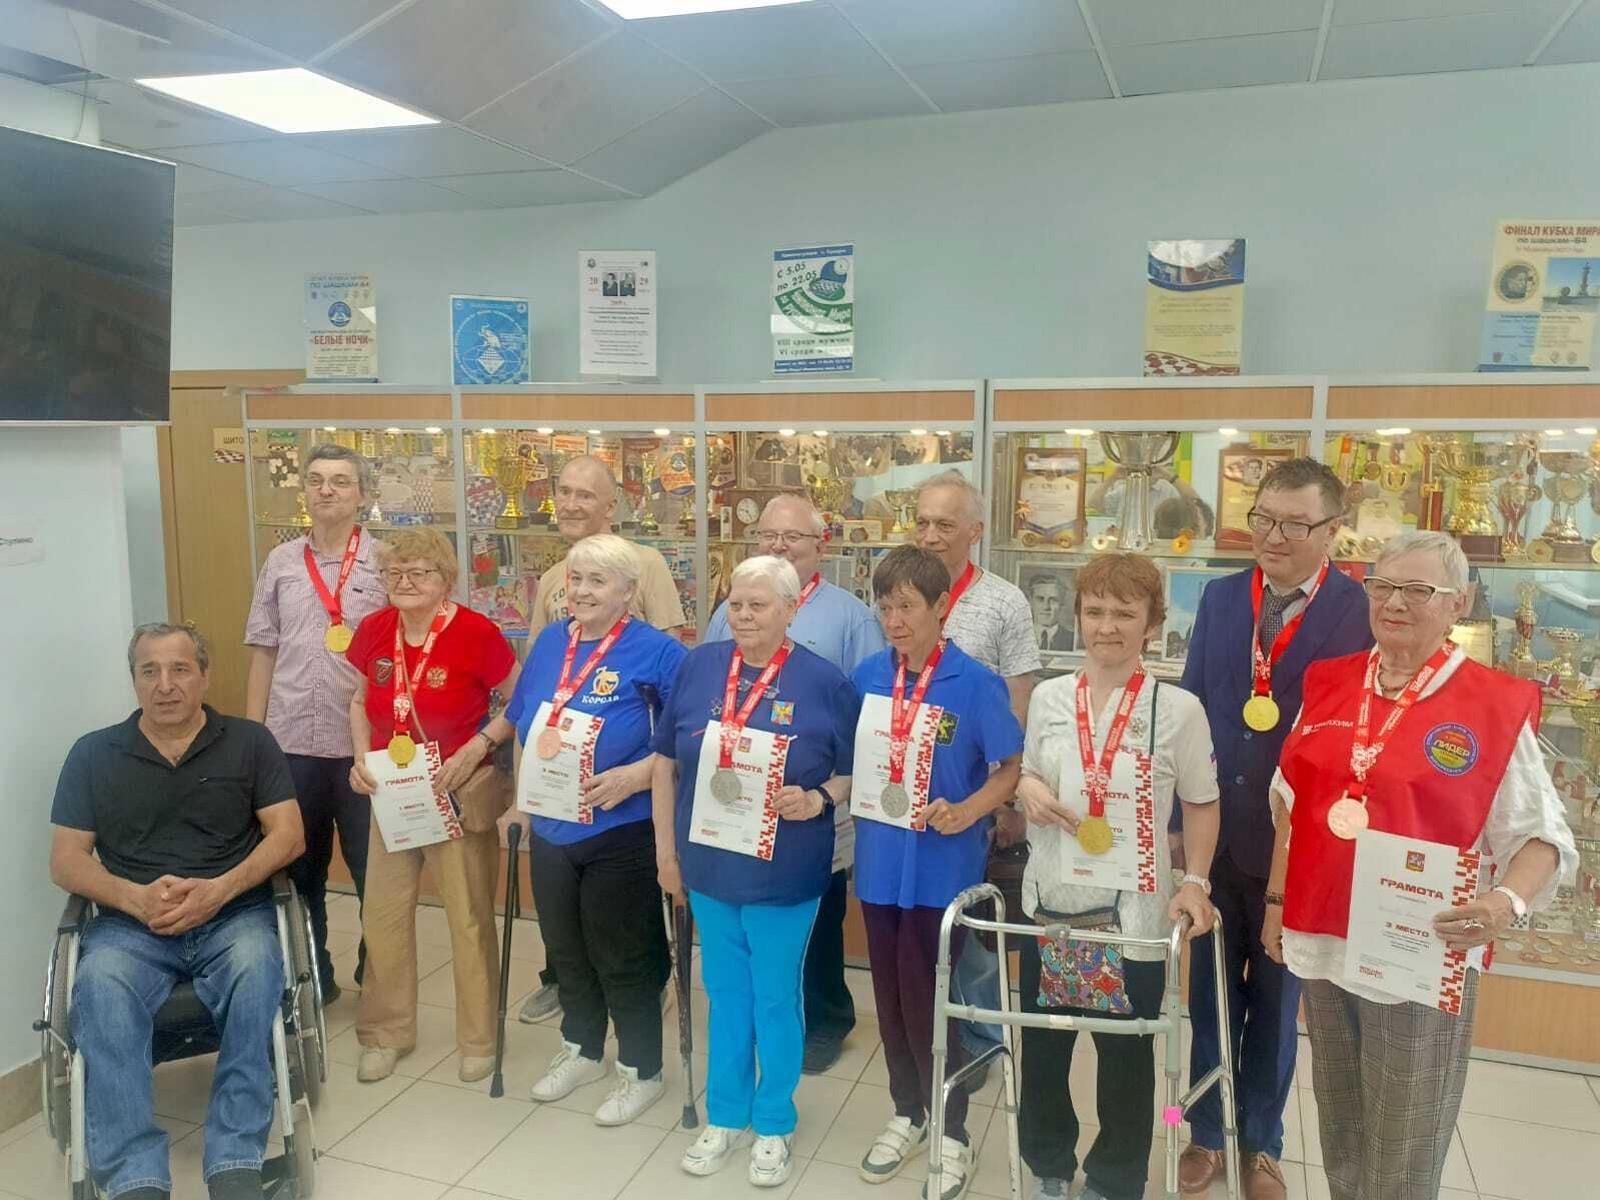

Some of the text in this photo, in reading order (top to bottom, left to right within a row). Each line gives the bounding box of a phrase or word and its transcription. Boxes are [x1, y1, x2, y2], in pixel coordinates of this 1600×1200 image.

[1504, 225, 1541, 236] ФИНАЛ
[1542, 226, 1574, 236] КУБКА
[792, 271, 817, 287] 22.05
[1432, 739, 1471, 757] ЛИДЕР
[385, 775, 425, 787] ГРАМОТА
[1380, 877, 1444, 900] ГРАМОТА
[1395, 924, 1430, 938] МЕСТО
